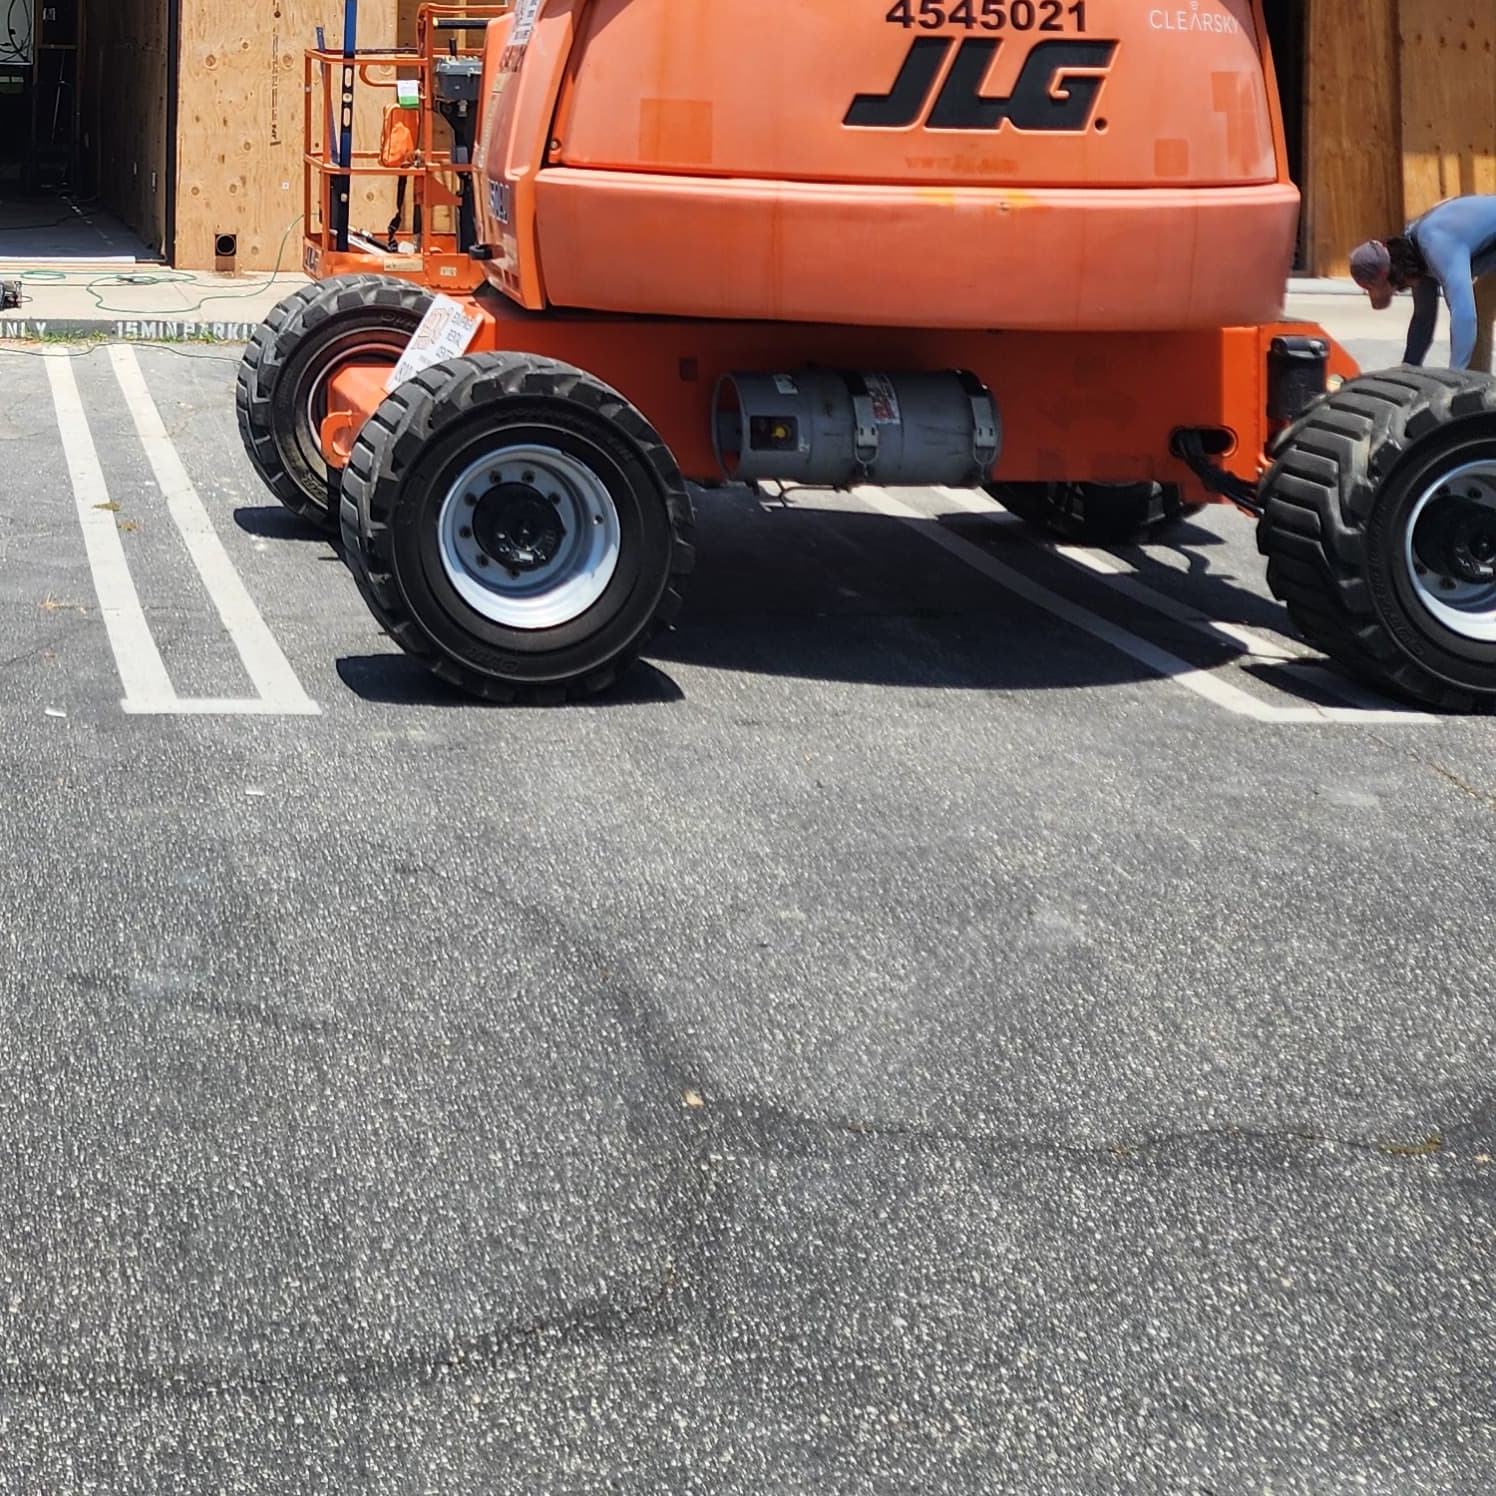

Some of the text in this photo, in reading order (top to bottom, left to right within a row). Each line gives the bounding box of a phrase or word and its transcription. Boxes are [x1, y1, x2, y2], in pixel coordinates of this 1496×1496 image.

[1149, 8, 1239, 35] CLEARSKY
[842, 35, 1121, 133] JLG
[184, 322, 256, 340] PARKI
